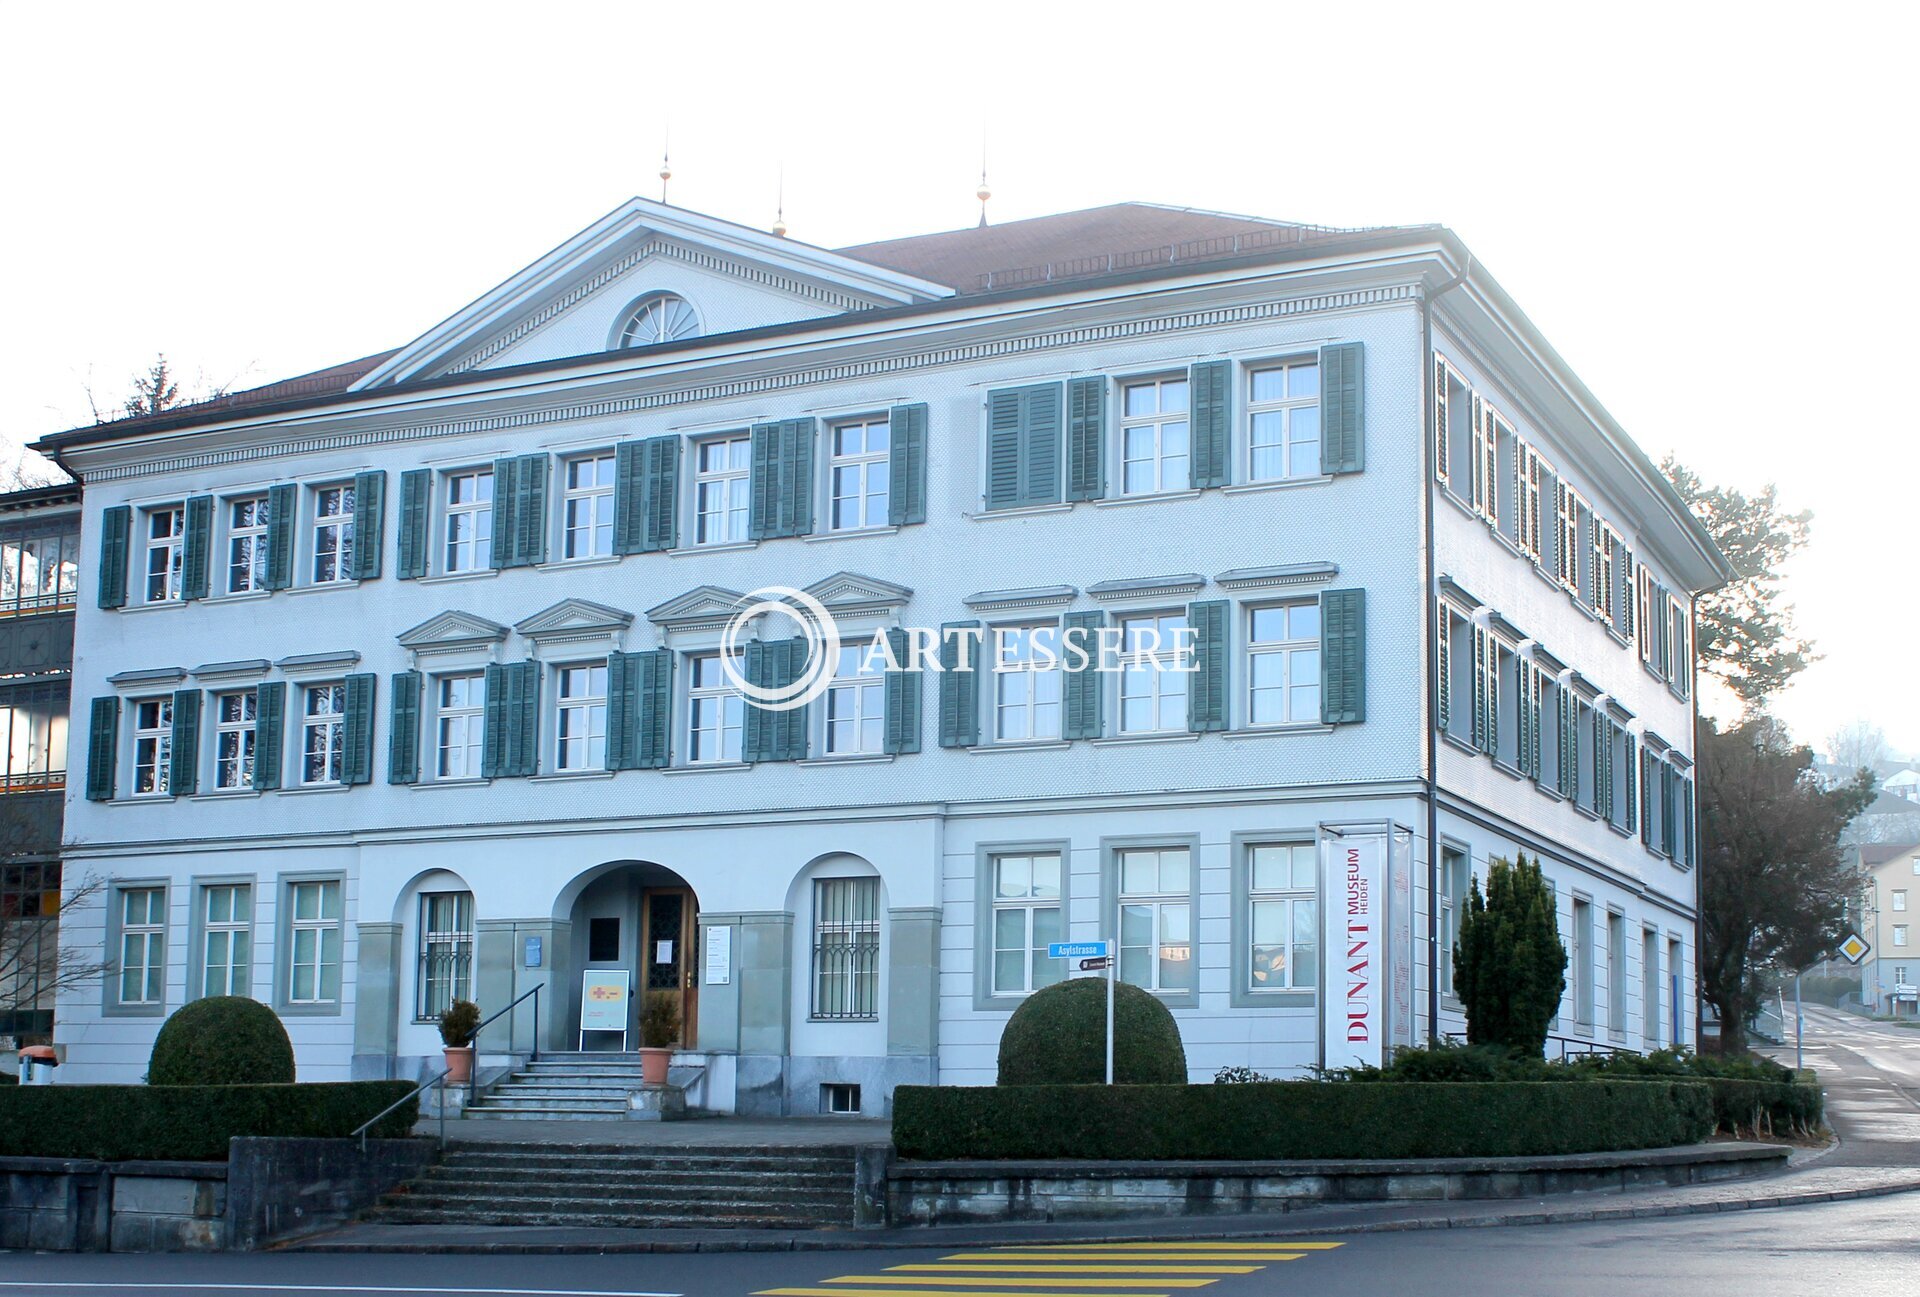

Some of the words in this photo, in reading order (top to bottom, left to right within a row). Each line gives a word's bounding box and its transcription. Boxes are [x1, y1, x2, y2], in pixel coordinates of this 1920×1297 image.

[1347, 848, 1359, 915] MUSEUM
[1360, 878, 1368, 915] HEIDEN
[1058, 945, 1097, 956] Asylstrasse
[1347, 919, 1369, 1044] DUNANT
